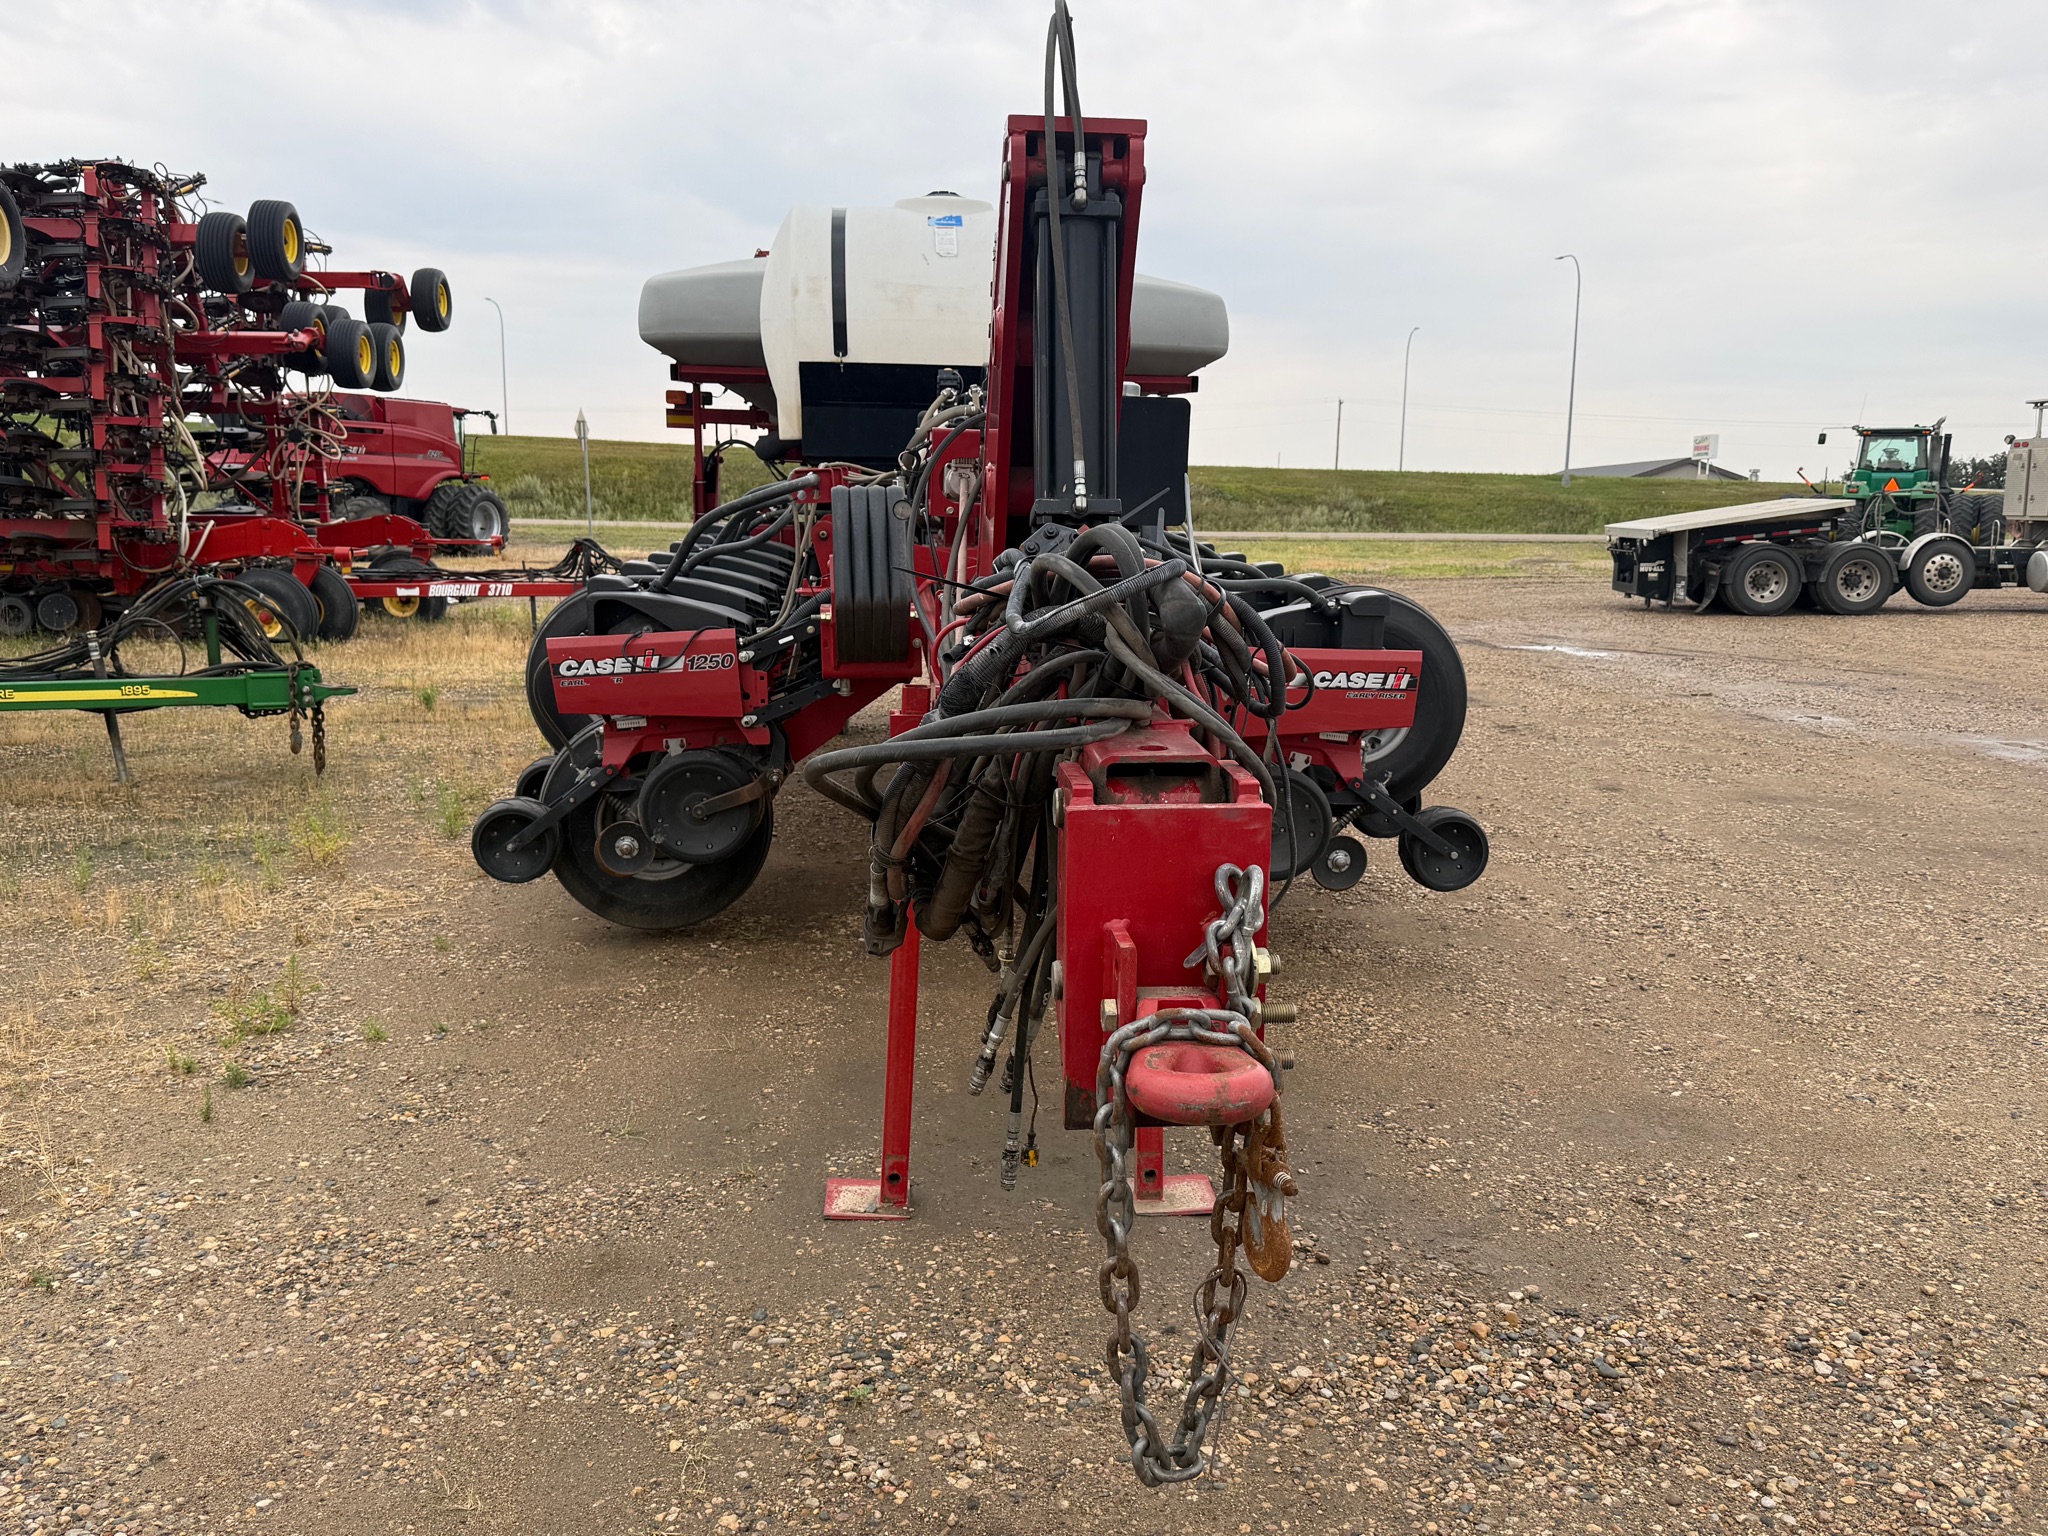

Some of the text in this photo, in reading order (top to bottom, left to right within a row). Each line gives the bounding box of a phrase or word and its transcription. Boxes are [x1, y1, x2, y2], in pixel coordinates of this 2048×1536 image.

[428, 583, 513, 596] BOURGAULT 3710
[559, 657, 633, 677] CASE
[686, 653, 735, 672] 1250
[1313, 670, 1386, 689] CASE
[120, 685, 150, 696] 1895
[1345, 691, 1406, 700] EARLY RISER
